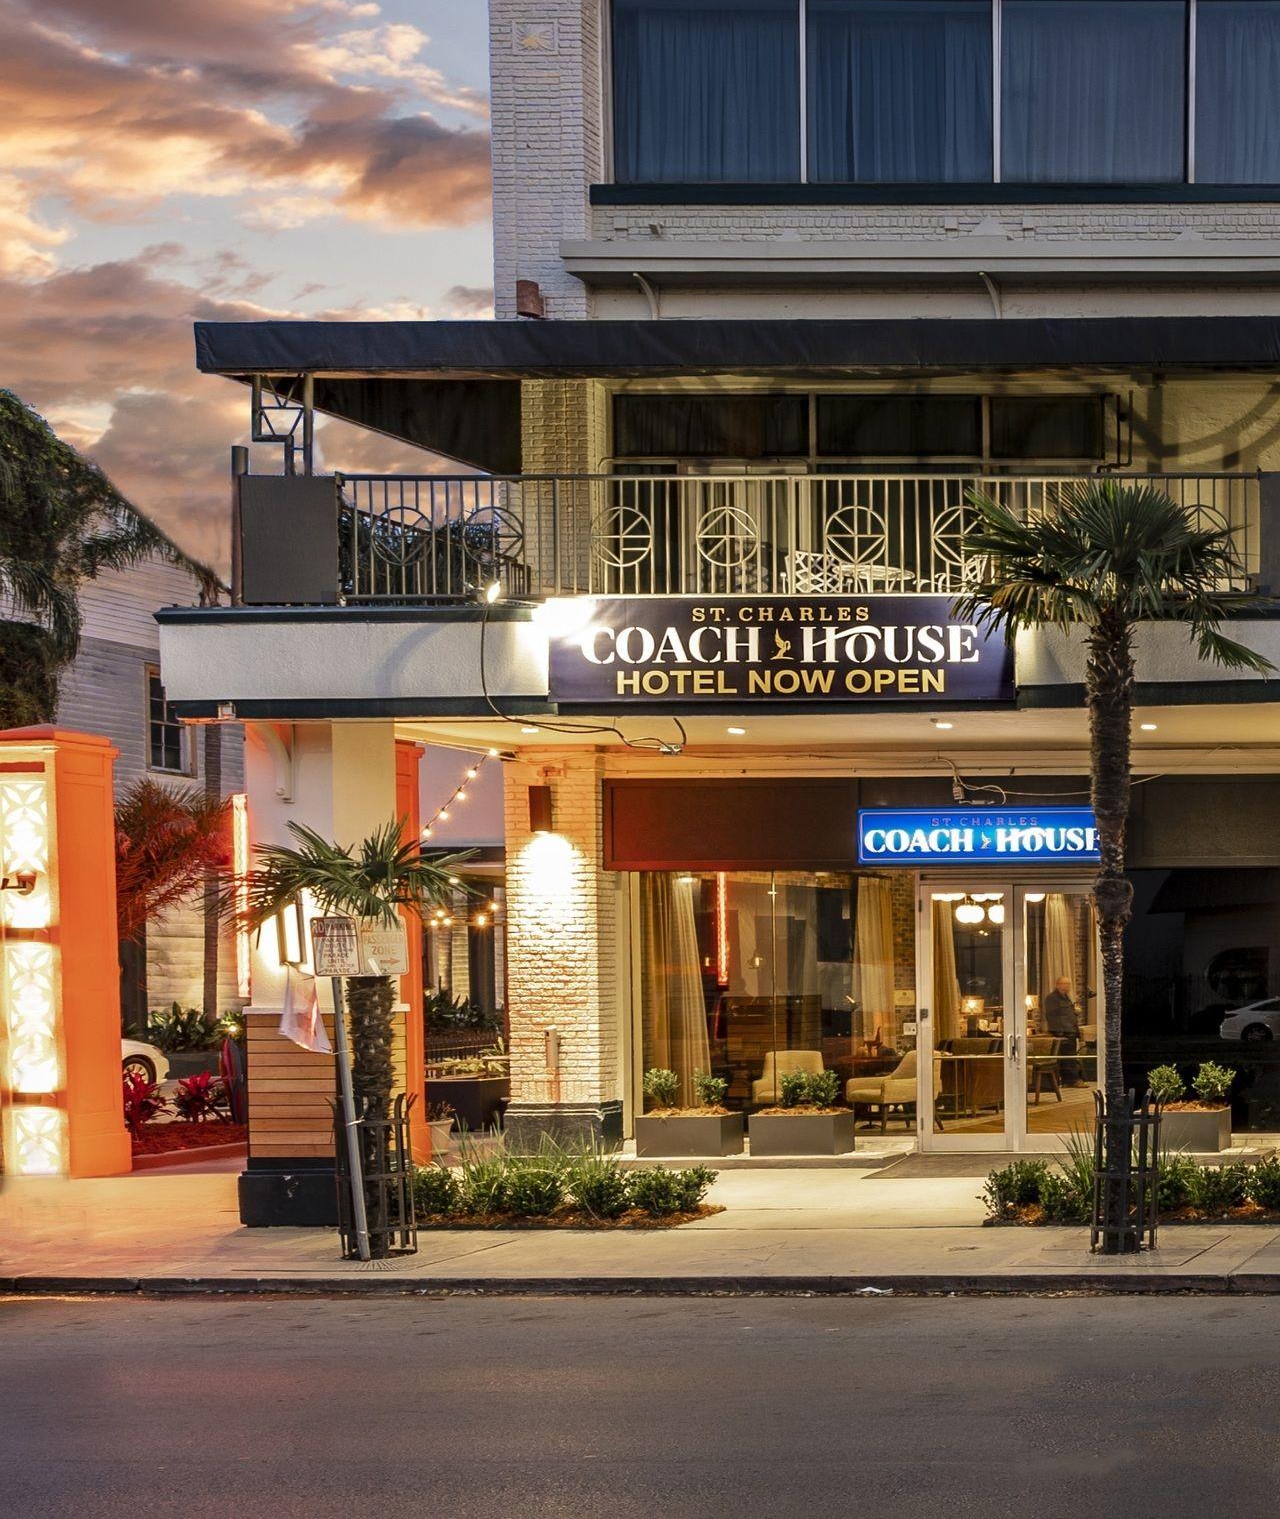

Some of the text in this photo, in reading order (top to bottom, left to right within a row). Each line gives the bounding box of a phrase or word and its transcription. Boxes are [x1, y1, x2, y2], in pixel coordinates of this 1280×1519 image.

[692, 607, 870, 622] ST. CHARLES
[581, 625, 980, 665] COACH HOUSE
[616, 668, 945, 695] HOTEL NOW OPEN
[959, 816, 1039, 827] CHARLES
[864, 828, 975, 854] COACH
[371, 945, 398, 955] ZONE
